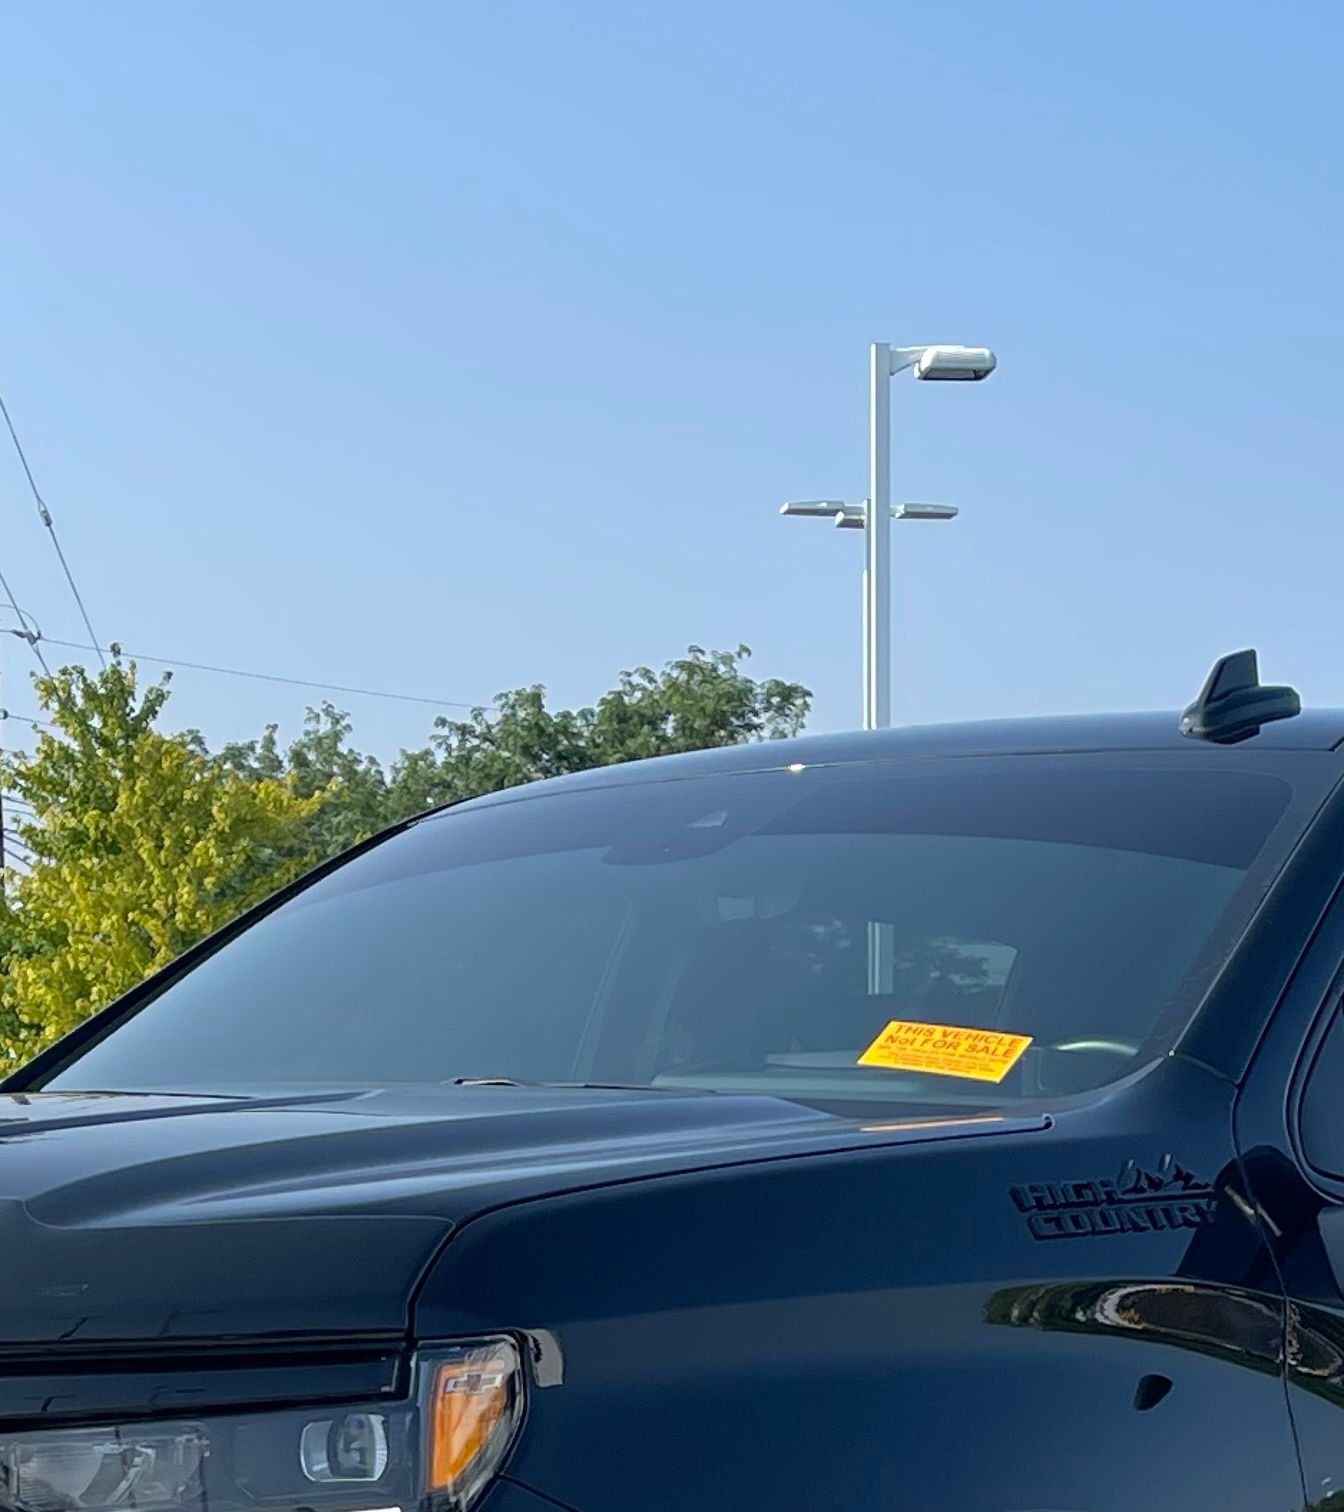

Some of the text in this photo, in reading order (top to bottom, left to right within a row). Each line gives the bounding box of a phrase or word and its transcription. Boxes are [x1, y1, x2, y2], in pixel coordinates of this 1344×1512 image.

[894, 1023, 1024, 1048] THIS VEHICLE
[921, 1037, 961, 1051] FOR
[965, 1044, 1017, 1059] SALE
[1009, 1178, 1120, 1213] HIGH
[1027, 1199, 1221, 1242] COUNTRY
